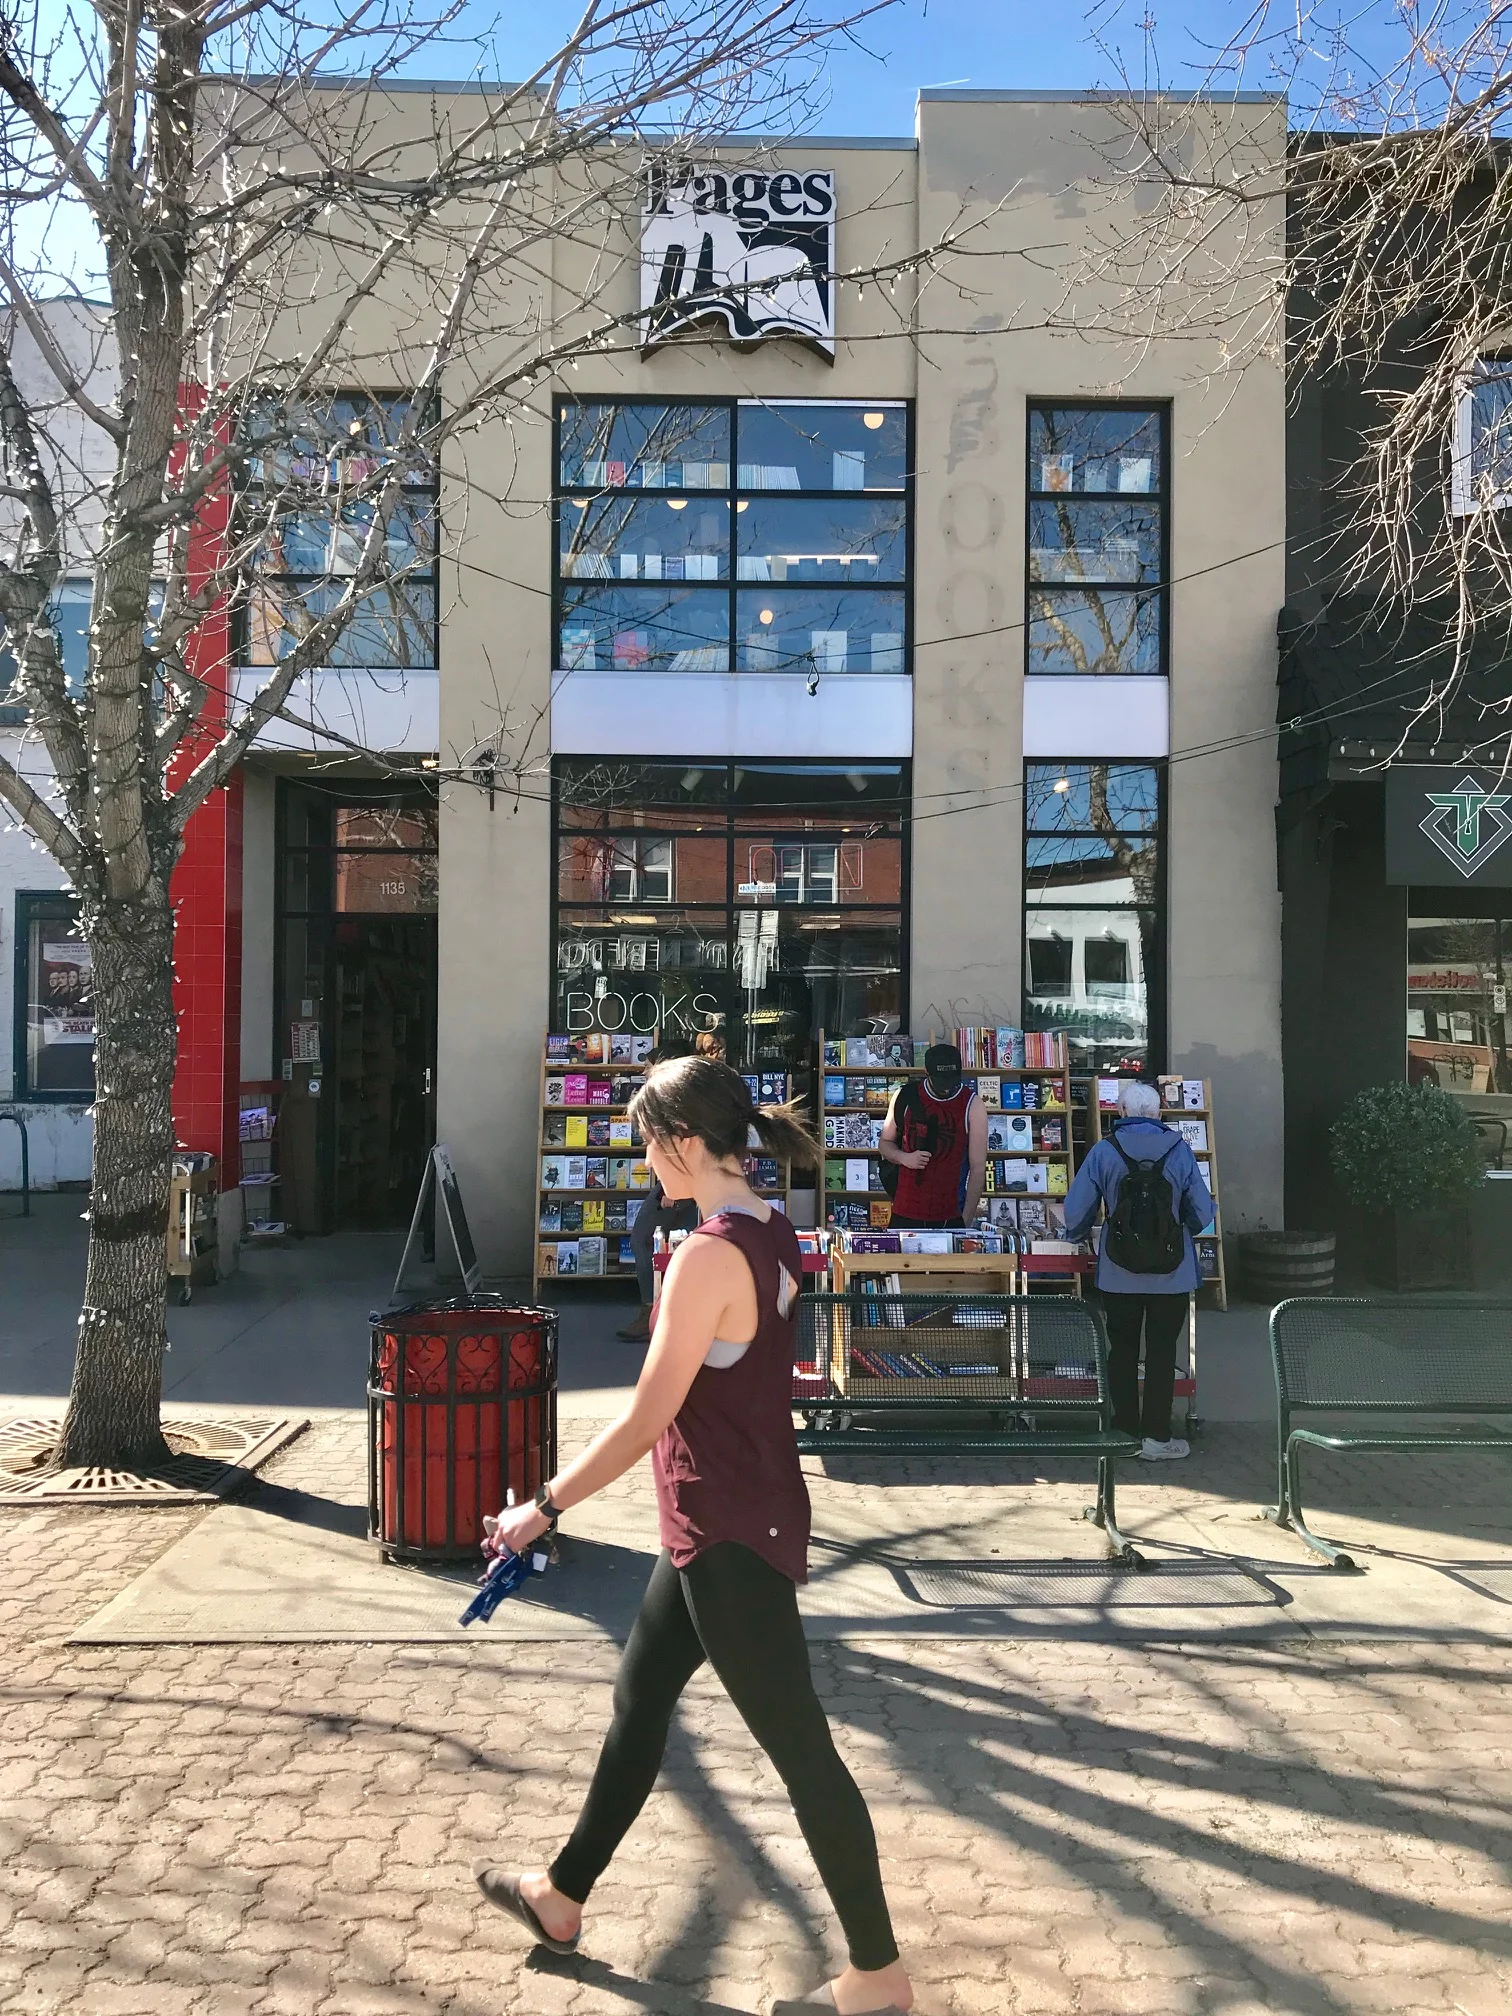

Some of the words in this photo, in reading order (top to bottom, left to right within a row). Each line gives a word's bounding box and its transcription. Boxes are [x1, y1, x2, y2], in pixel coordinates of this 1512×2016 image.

[642, 157, 833, 231] Pages
[380, 882, 406, 895] 1135
[566, 992, 718, 1033] BOOKS
[836, 1120, 845, 1149] MAKING
